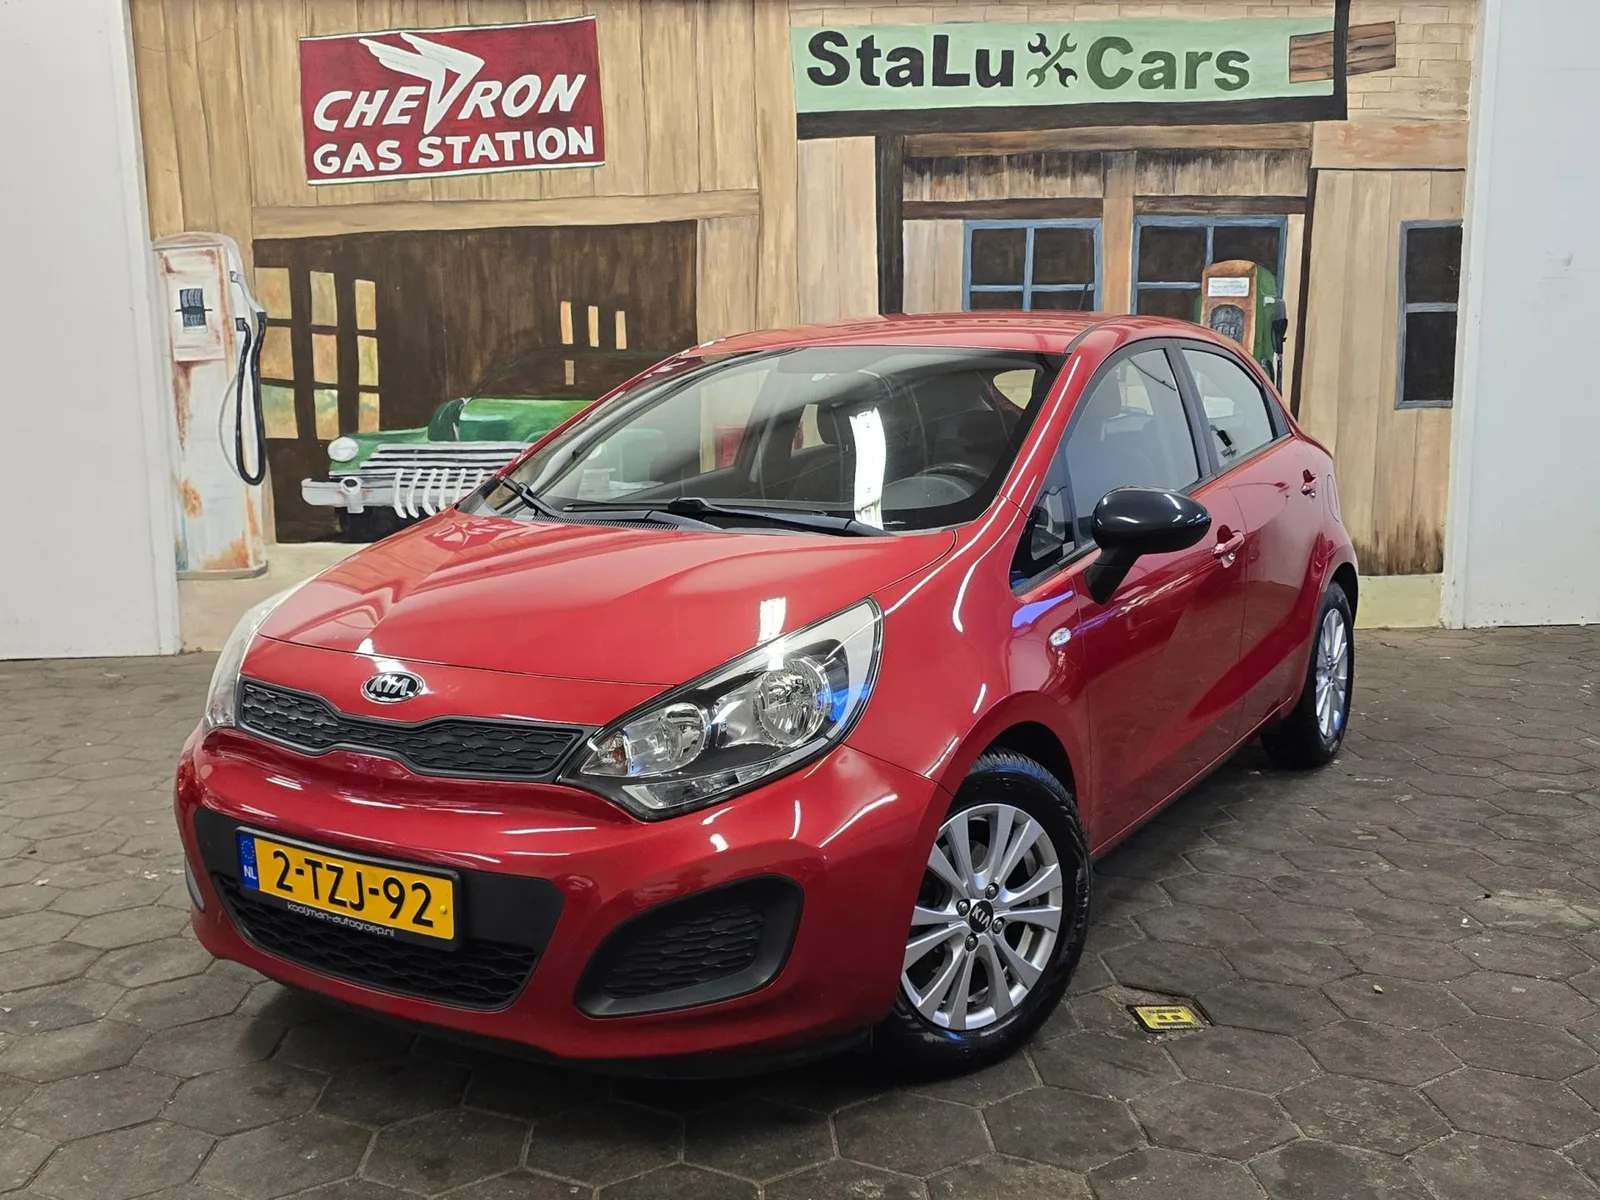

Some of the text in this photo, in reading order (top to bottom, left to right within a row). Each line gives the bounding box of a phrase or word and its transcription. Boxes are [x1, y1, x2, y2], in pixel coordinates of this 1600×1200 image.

[807, 31, 1251, 92] StaLu Cars
[313, 62, 587, 135] CHEVRON
[313, 126, 594, 174] GAS STATION
[368, 675, 411, 696] KIA
[243, 864, 258, 881] NL
[272, 850, 434, 928] 2-TZJ-92
[971, 905, 991, 928] KIA
